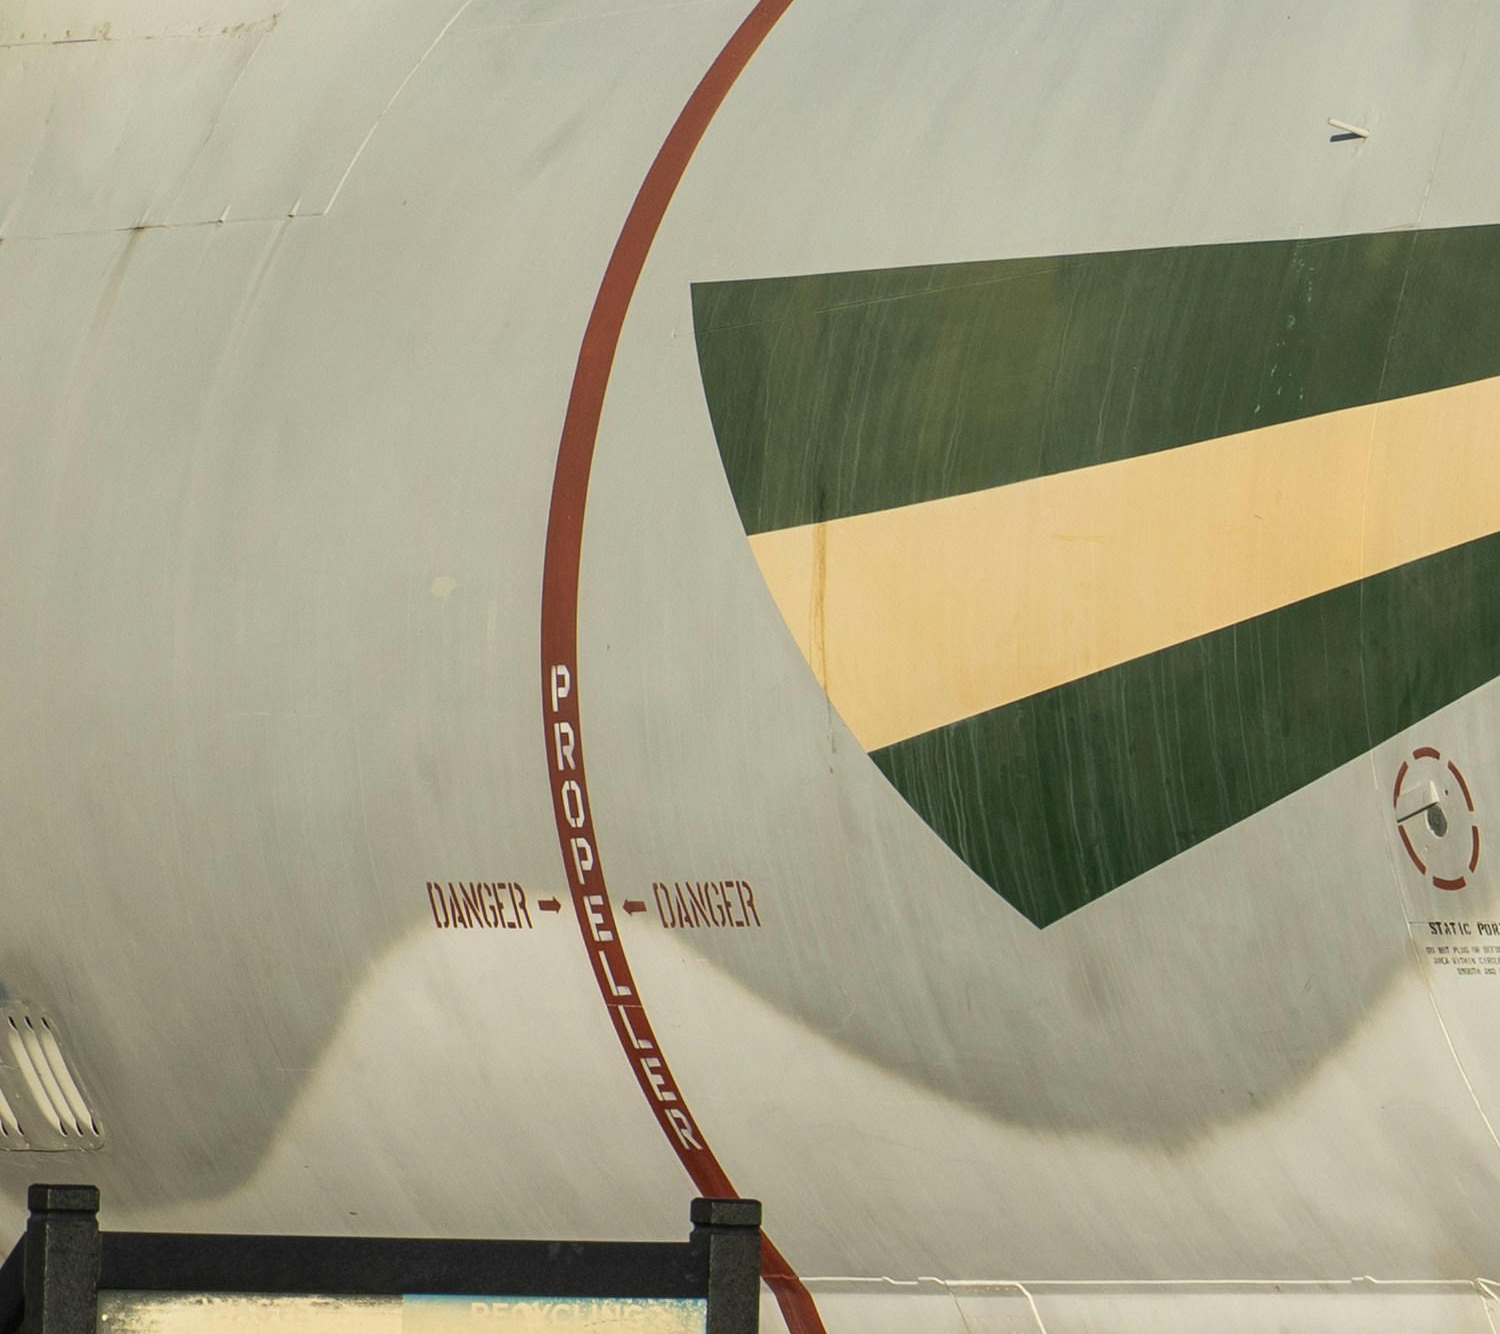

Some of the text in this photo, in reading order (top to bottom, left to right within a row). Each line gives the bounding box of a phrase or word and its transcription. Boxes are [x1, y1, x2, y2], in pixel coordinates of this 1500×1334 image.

[425, 881, 533, 930] DANGER
[550, 663, 703, 1152] PROPELLER
[652, 880, 761, 929] DANGER
[1428, 921, 1471, 936] STATIC
